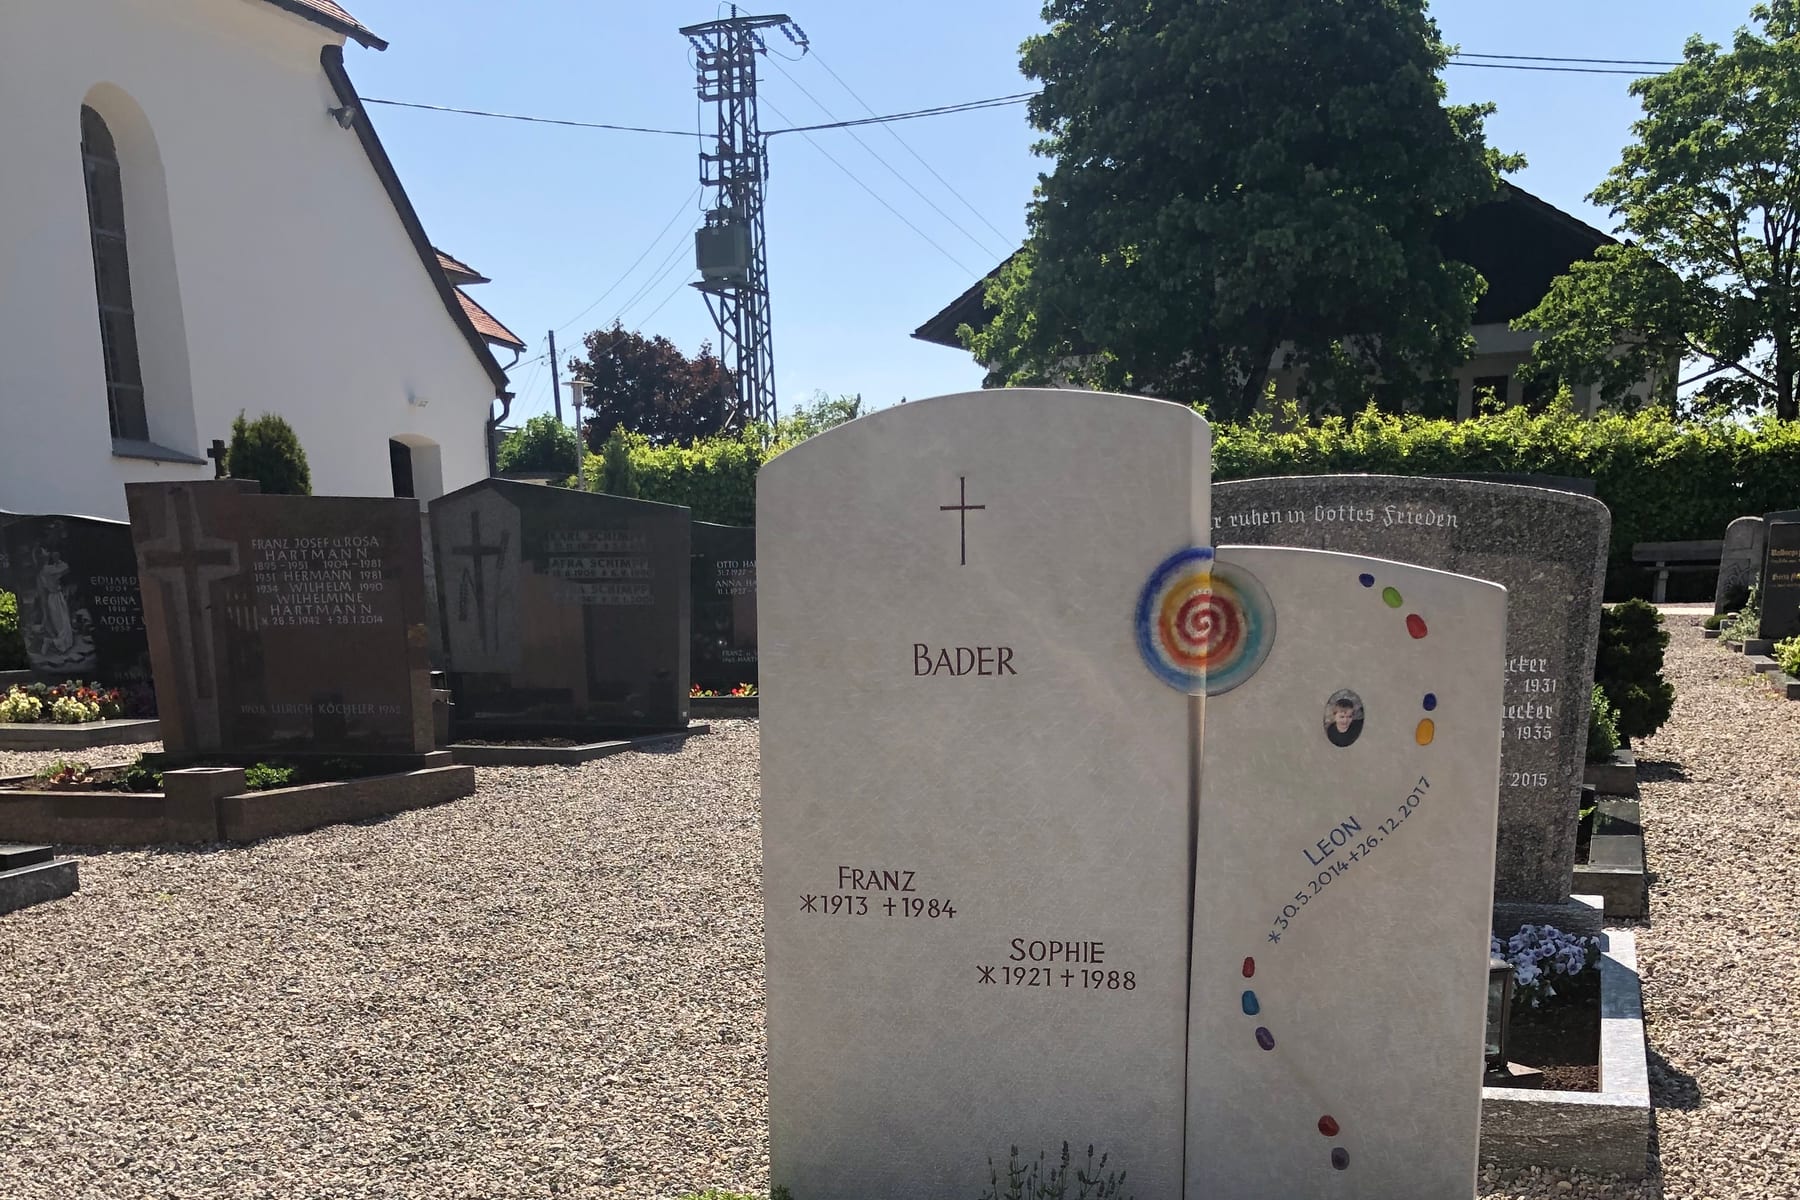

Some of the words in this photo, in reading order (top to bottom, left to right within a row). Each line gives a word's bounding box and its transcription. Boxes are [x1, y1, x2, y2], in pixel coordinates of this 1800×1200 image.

[1230, 509, 1282, 527] ruhen
[1288, 510, 1306, 524] in
[1383, 504, 1458, 528] Frieden
[251, 538, 289, 549] FRANZ
[295, 537, 329, 549] JOSEF
[344, 536, 379, 547] ROSA
[265, 548, 368, 561] HARTMANN
[288, 561, 309, 571] 1951
[323, 560, 348, 569] 1904
[360, 559, 382, 569] 1981
[716, 560, 739, 569] OTTO
[90, 575, 137, 585] EDUARD
[284, 570, 352, 582] HERMANN
[360, 570, 383, 580] 1981
[289, 581, 352, 593] WILHELM
[715, 580, 743, 588] ANNA
[94, 594, 137, 606] REGINA
[276, 593, 364, 605] WILHELMINE
[270, 604, 372, 616] HARTMANN
[100, 615, 137, 625] ADOLF
[913, 643, 1018, 676] BADER
[1524, 678, 1557, 693] 1931
[1516, 725, 1553, 741] 1935
[1510, 772, 1548, 787] 2015
[1302, 815, 1362, 867] LEON
[838, 866, 916, 892] FRANZ
[1009, 937, 1106, 964] SOPHIE
